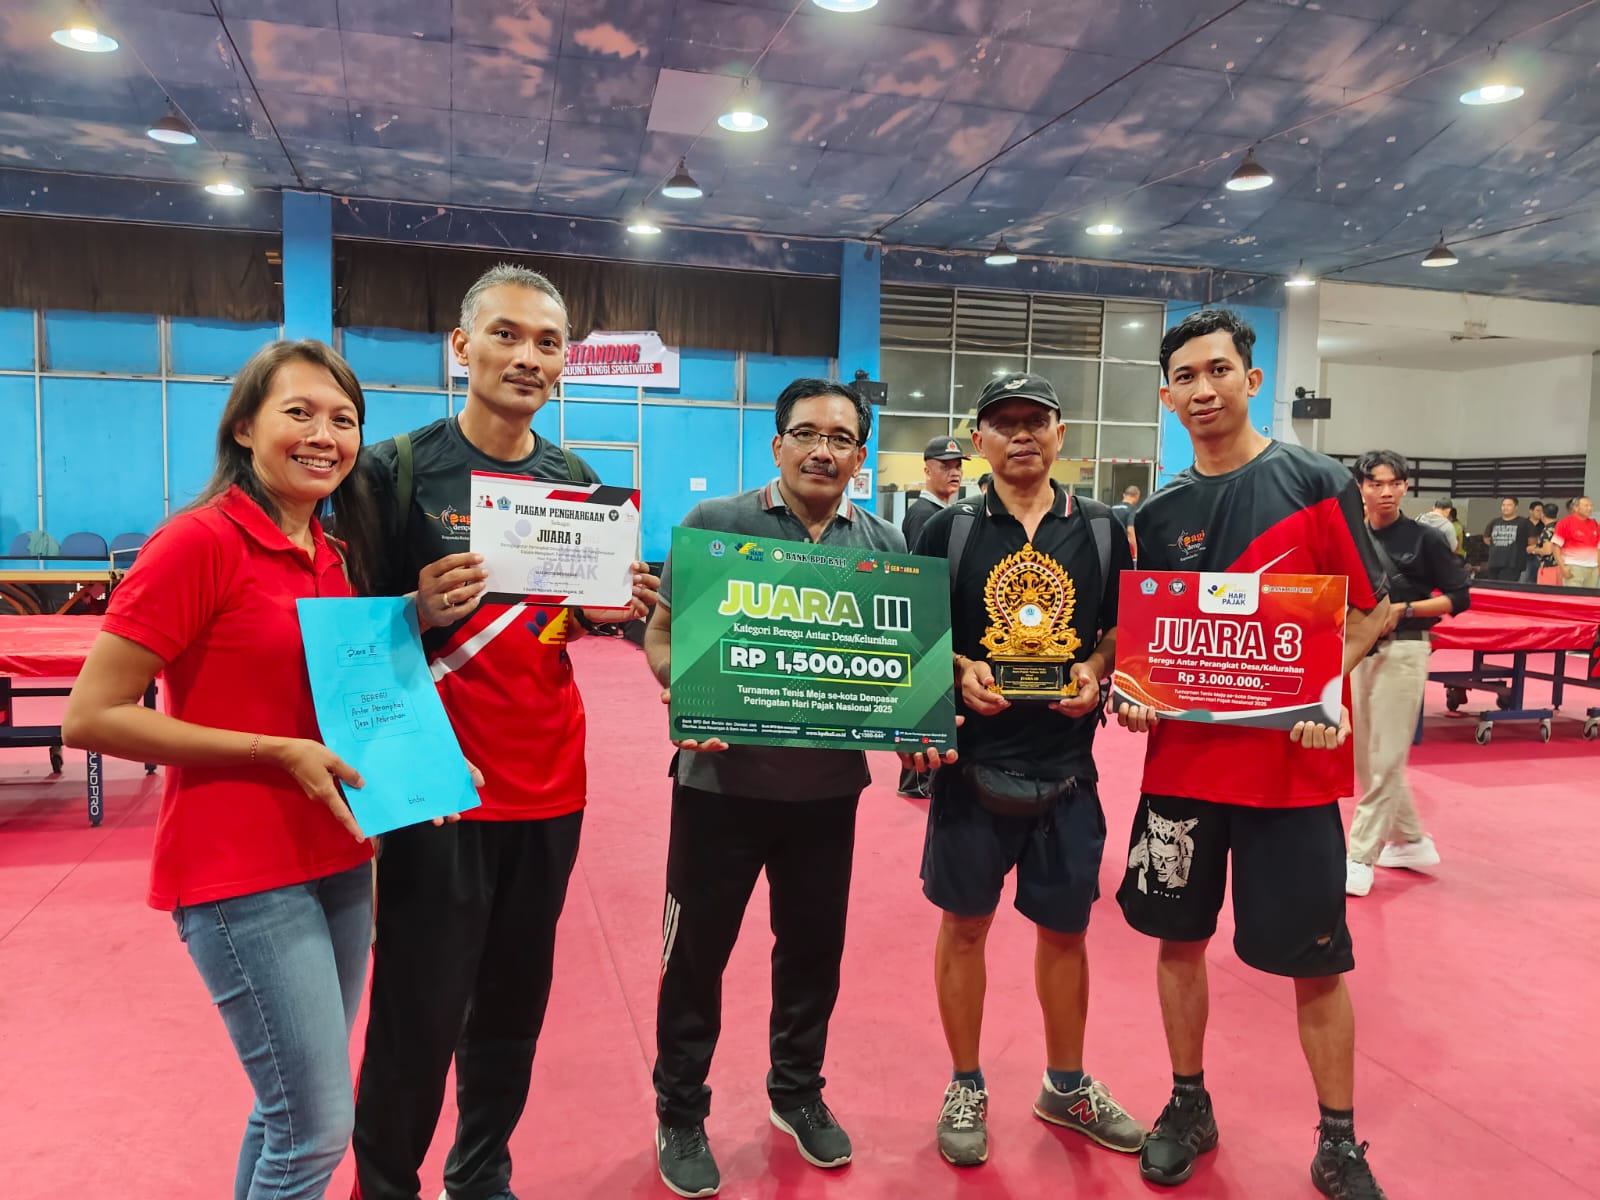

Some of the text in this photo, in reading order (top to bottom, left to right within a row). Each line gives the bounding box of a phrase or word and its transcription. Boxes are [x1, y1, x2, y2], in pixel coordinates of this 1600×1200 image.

[588, 365, 610, 375] TINGGI
[612, 363, 654, 374] SPORTIVITAS
[515, 504, 605, 522] PIAGAM PENGHARGAAN
[537, 529, 582, 546] JUARA 3
[785, 552, 807, 562] BANK
[810, 555, 826, 564] BPD
[828, 557, 847, 567] BALI
[718, 580, 912, 632] JUARA III
[733, 623, 898, 646] Kategori Beregu Antar Desa/Kelurahan
[1148, 617, 1302, 663] JUARA 3
[730, 646, 902, 679] RP 1,500,000
[1148, 656, 1305, 673] Beregu Antar Perangkat Desa/Kelurahan
[1178, 672, 1270, 690] Rp 3.000.000,-
[737, 685, 898, 705] Turnamen Tenis Meja se-kota Denpasar
[743, 696, 893, 713] Peringatan Hari Pajak Nasional 2025
